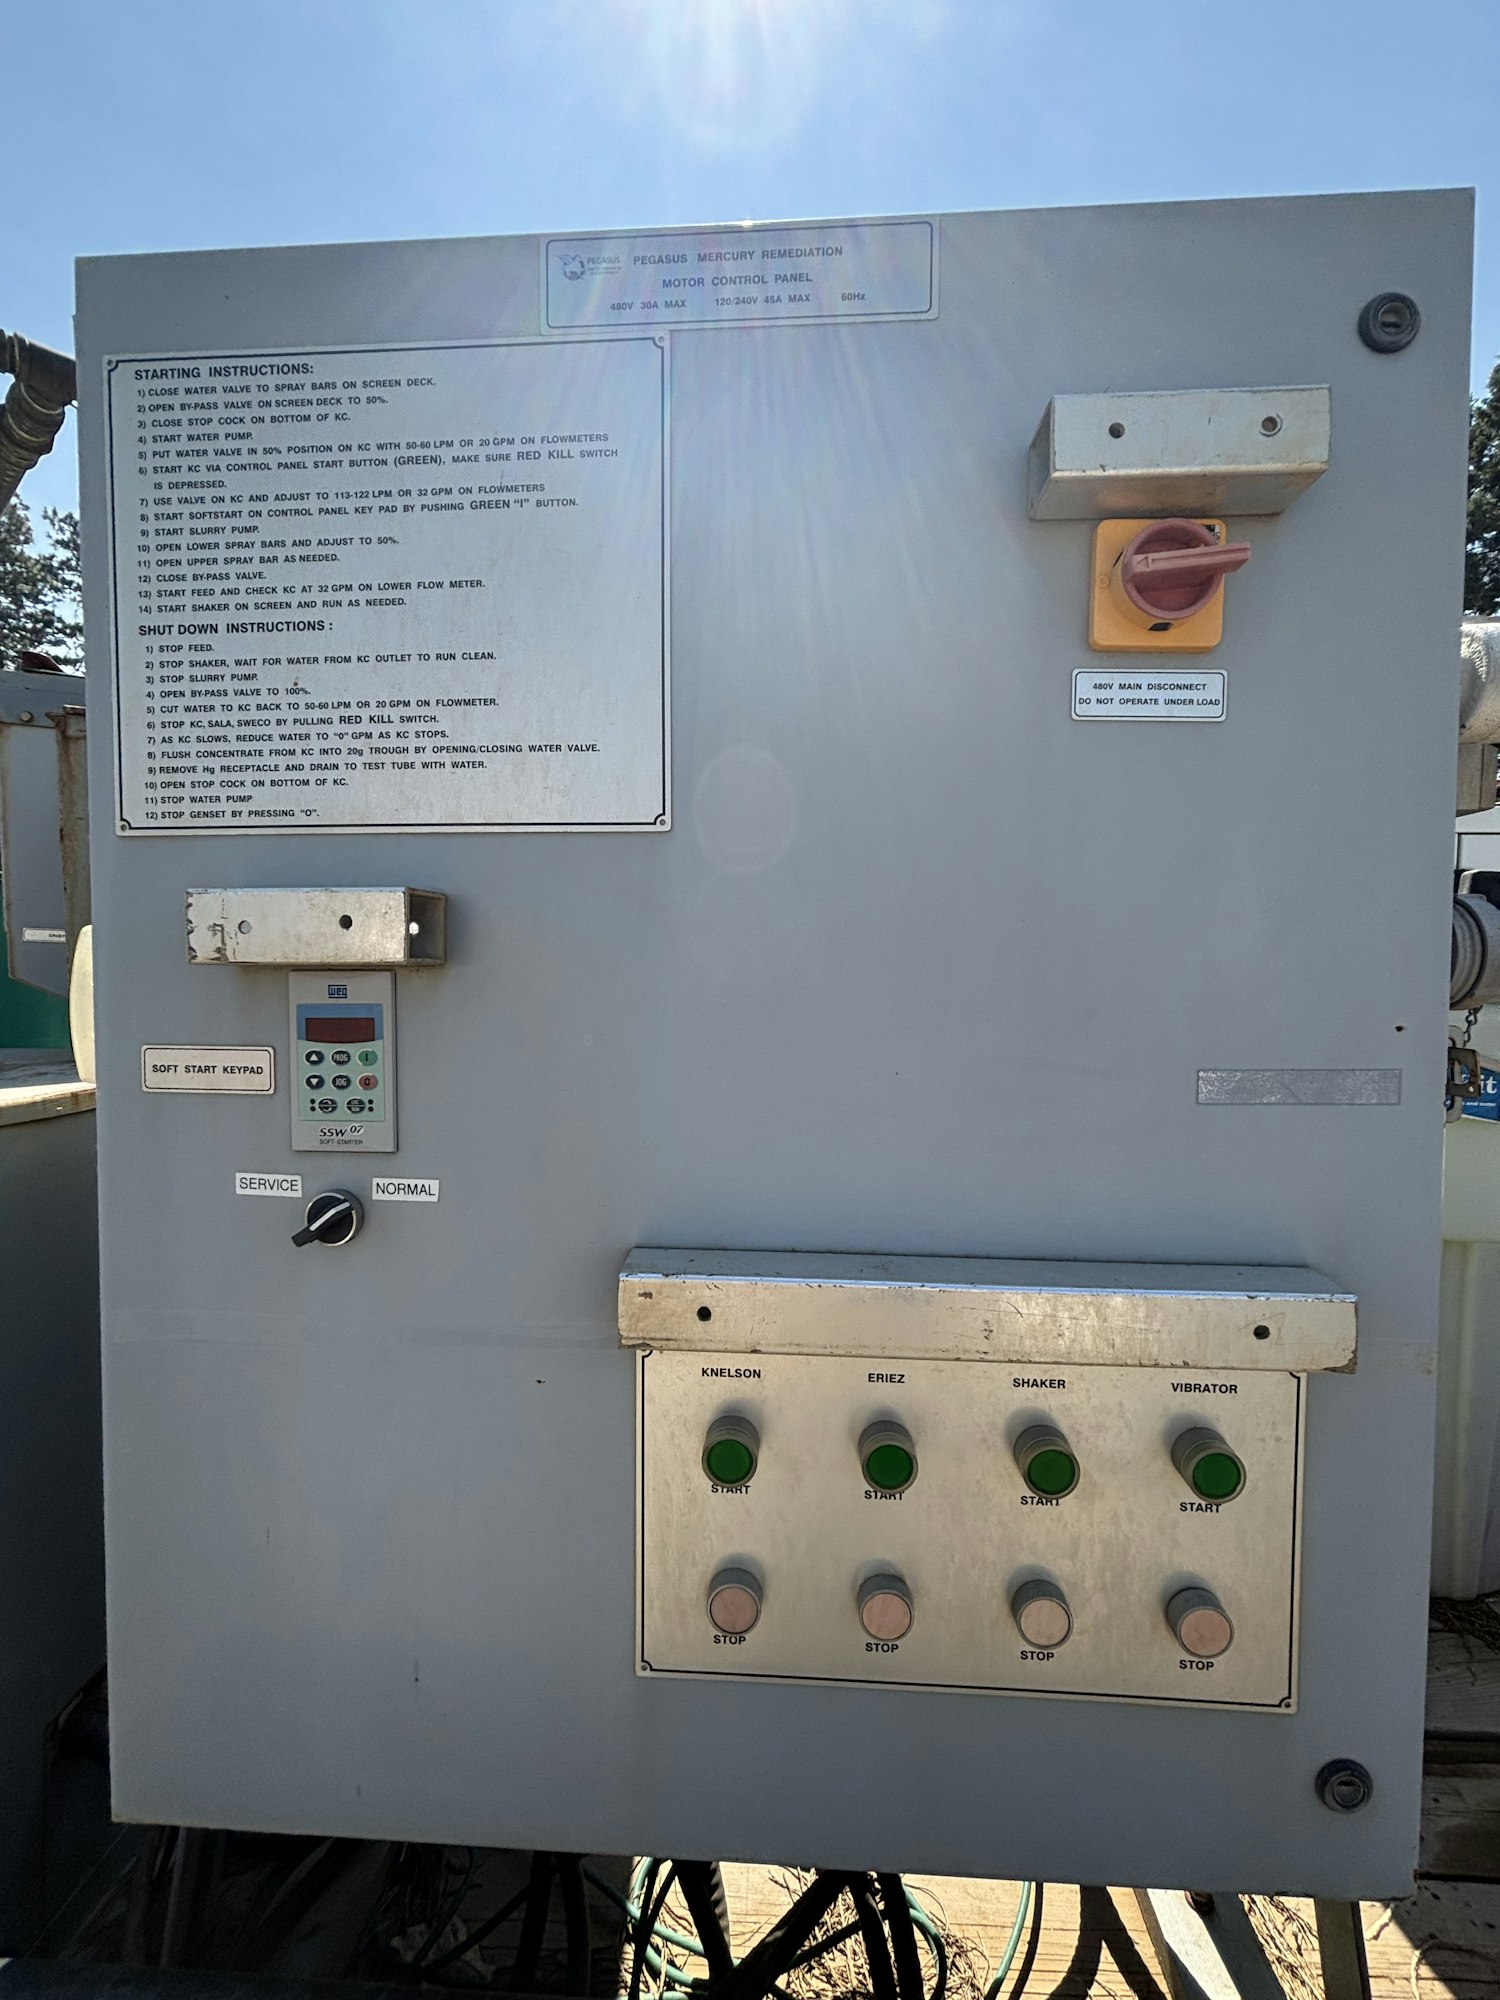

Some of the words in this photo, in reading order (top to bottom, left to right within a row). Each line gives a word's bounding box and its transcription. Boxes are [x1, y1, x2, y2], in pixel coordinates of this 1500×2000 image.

[633, 253, 688, 266] PEGASUS
[697, 250, 756, 263] MERCURY
[761, 246, 843, 260] REMEDIATION
[662, 277, 705, 289] MOTOR
[711, 274, 768, 287] CONTROL
[774, 272, 813, 284] PANEL
[610, 301, 634, 311] 480V
[640, 300, 659, 310] 30A
[664, 299, 687, 309] MAX
[714, 296, 758, 306] 120/240V
[763, 295, 782, 304] 45A
[788, 293, 811, 303] MAX
[841, 292, 866, 302] 60Hz
[134, 366, 201, 381] STARTING
[208, 362, 314, 378] INSTRUCTIONS:
[183, 386, 218, 396] WATER
[221, 384, 252, 394] VALVE
[255, 383, 270, 393] TO
[274, 382, 306, 392] SPRAY
[311, 381, 338, 391] BARS
[342, 380, 357, 390] ON
[361, 378, 402, 389] SCREEN
[406, 377, 437, 387] DECK.
[179, 401, 219, 411] BY-PASS
[223, 400, 253, 410] VALVE
[257, 399, 272, 409] ON
[274, 398, 314, 408] SCREEN
[315, 396, 343, 406] DECK
[347, 396, 361, 405] TO
[365, 395, 389, 405] 50%.
[137, 420, 147, 430] 3)
[151, 418, 183, 428] CLOSE
[187, 417, 214, 427] STOP
[217, 416, 246, 426] COCK
[250, 415, 265, 425] ON
[270, 414, 312, 424] BOTTOM
[316, 413, 330, 422] OF
[334, 412, 351, 422] KC.
[137, 435, 147, 446] 4)
[151, 434, 182, 444] START
[186, 432, 220, 442] WATER
[224, 431, 254, 441] PUMP.
[138, 466, 148, 477] 6)
[152, 465, 183, 475] START
[187, 464, 201, 473] KC
[205, 463, 222, 473] VIA
[225, 462, 273, 473] CONTROL
[277, 461, 309, 470] PANEL
[313, 459, 344, 470] START
[348, 458, 388, 468] BUTTON
[393, 454, 446, 469] (GREEN),
[451, 454, 480, 464] MAKE
[485, 453, 512, 462] SURE
[517, 450, 542, 461] RED
[548, 449, 575, 460] KILL
[579, 448, 618, 459] SWITCH
[153, 481, 163, 491] IS
[168, 479, 227, 490] DEPRESSED.
[140, 529, 150, 539] 9)
[154, 527, 185, 537] START
[189, 526, 227, 536] SLURRY
[231, 525, 260, 534] PUMP.
[137, 574, 152, 585] 12)
[156, 573, 188, 583] CLOSE
[192, 572, 231, 582] BY-PASS
[235, 571, 267, 580] VALVE.
[138, 624, 175, 636] SHUT
[177, 623, 219, 635] DOWN
[145, 645, 154, 655] 1)
[158, 644, 184, 653] STOP
[188, 643, 215, 652] FEED.
[145, 661, 154, 671] 2)
[159, 660, 184, 669] STOP
[188, 659, 230, 668] SHAKER,
[234, 658, 258, 667] WAIT
[262, 657, 282, 666] FOR
[286, 656, 319, 665] WATER
[324, 655, 352, 664] FROM
[356, 655, 370, 663] KC
[375, 653, 413, 663] OUTLET
[416, 653, 431, 662] TO
[435, 652, 457, 661] RUN
[461, 651, 497, 661] CLEAN.
[145, 675, 155, 685] 3)
[159, 674, 185, 684] STOP
[189, 673, 226, 683] SLURRY
[230, 673, 259, 682] PUMP.
[1147, 683, 1207, 691] DISCONNECT
[145, 691, 155, 701] 4)
[159, 690, 186, 699] OPEN
[190, 688, 229, 698] BY-PASS
[233, 688, 262, 697] VALVE
[266, 687, 280, 696] TO
[284, 687, 311, 696] 100%.
[1078, 697, 1091, 705] DO
[1096, 697, 1114, 705] NOT
[1119, 697, 1159, 705] OPERATE
[1164, 698, 1194, 706] UNDER
[1197, 698, 1220, 706] LOAD
[146, 721, 156, 731] 6)
[160, 720, 185, 729] STOP
[236, 718, 271, 728] SWECO
[275, 718, 288, 727] BY
[293, 717, 334, 726] PULLING
[339, 715, 363, 725] RED
[368, 714, 395, 724] KILL
[399, 714, 440, 724] SWITCH.
[189, 795, 221, 804] WATER
[226, 794, 253, 803] PUMP
[333, 1053, 348, 1061] PROG
[152, 1064, 179, 1074] SOFT
[184, 1065, 217, 1075] START
[222, 1065, 264, 1075] KEYPAD
[335, 1078, 347, 1086] JOG
[319, 1127, 347, 1137] SSW
[350, 1125, 363, 1133] 07
[239, 1177, 299, 1192] SERVICE
[376, 1182, 436, 1196] NORMAL
[701, 1367, 762, 1379] KNELSON
[868, 1372, 905, 1384] ERIEZ
[1013, 1377, 1066, 1389] SHAKER
[1171, 1382, 1238, 1394] VIBRATOR
[1179, 1502, 1222, 1513] START
[713, 1634, 746, 1645] STOP
[865, 1642, 899, 1653] STOP
[1020, 1650, 1054, 1661] STOP
[1179, 1659, 1214, 1671] STOP
